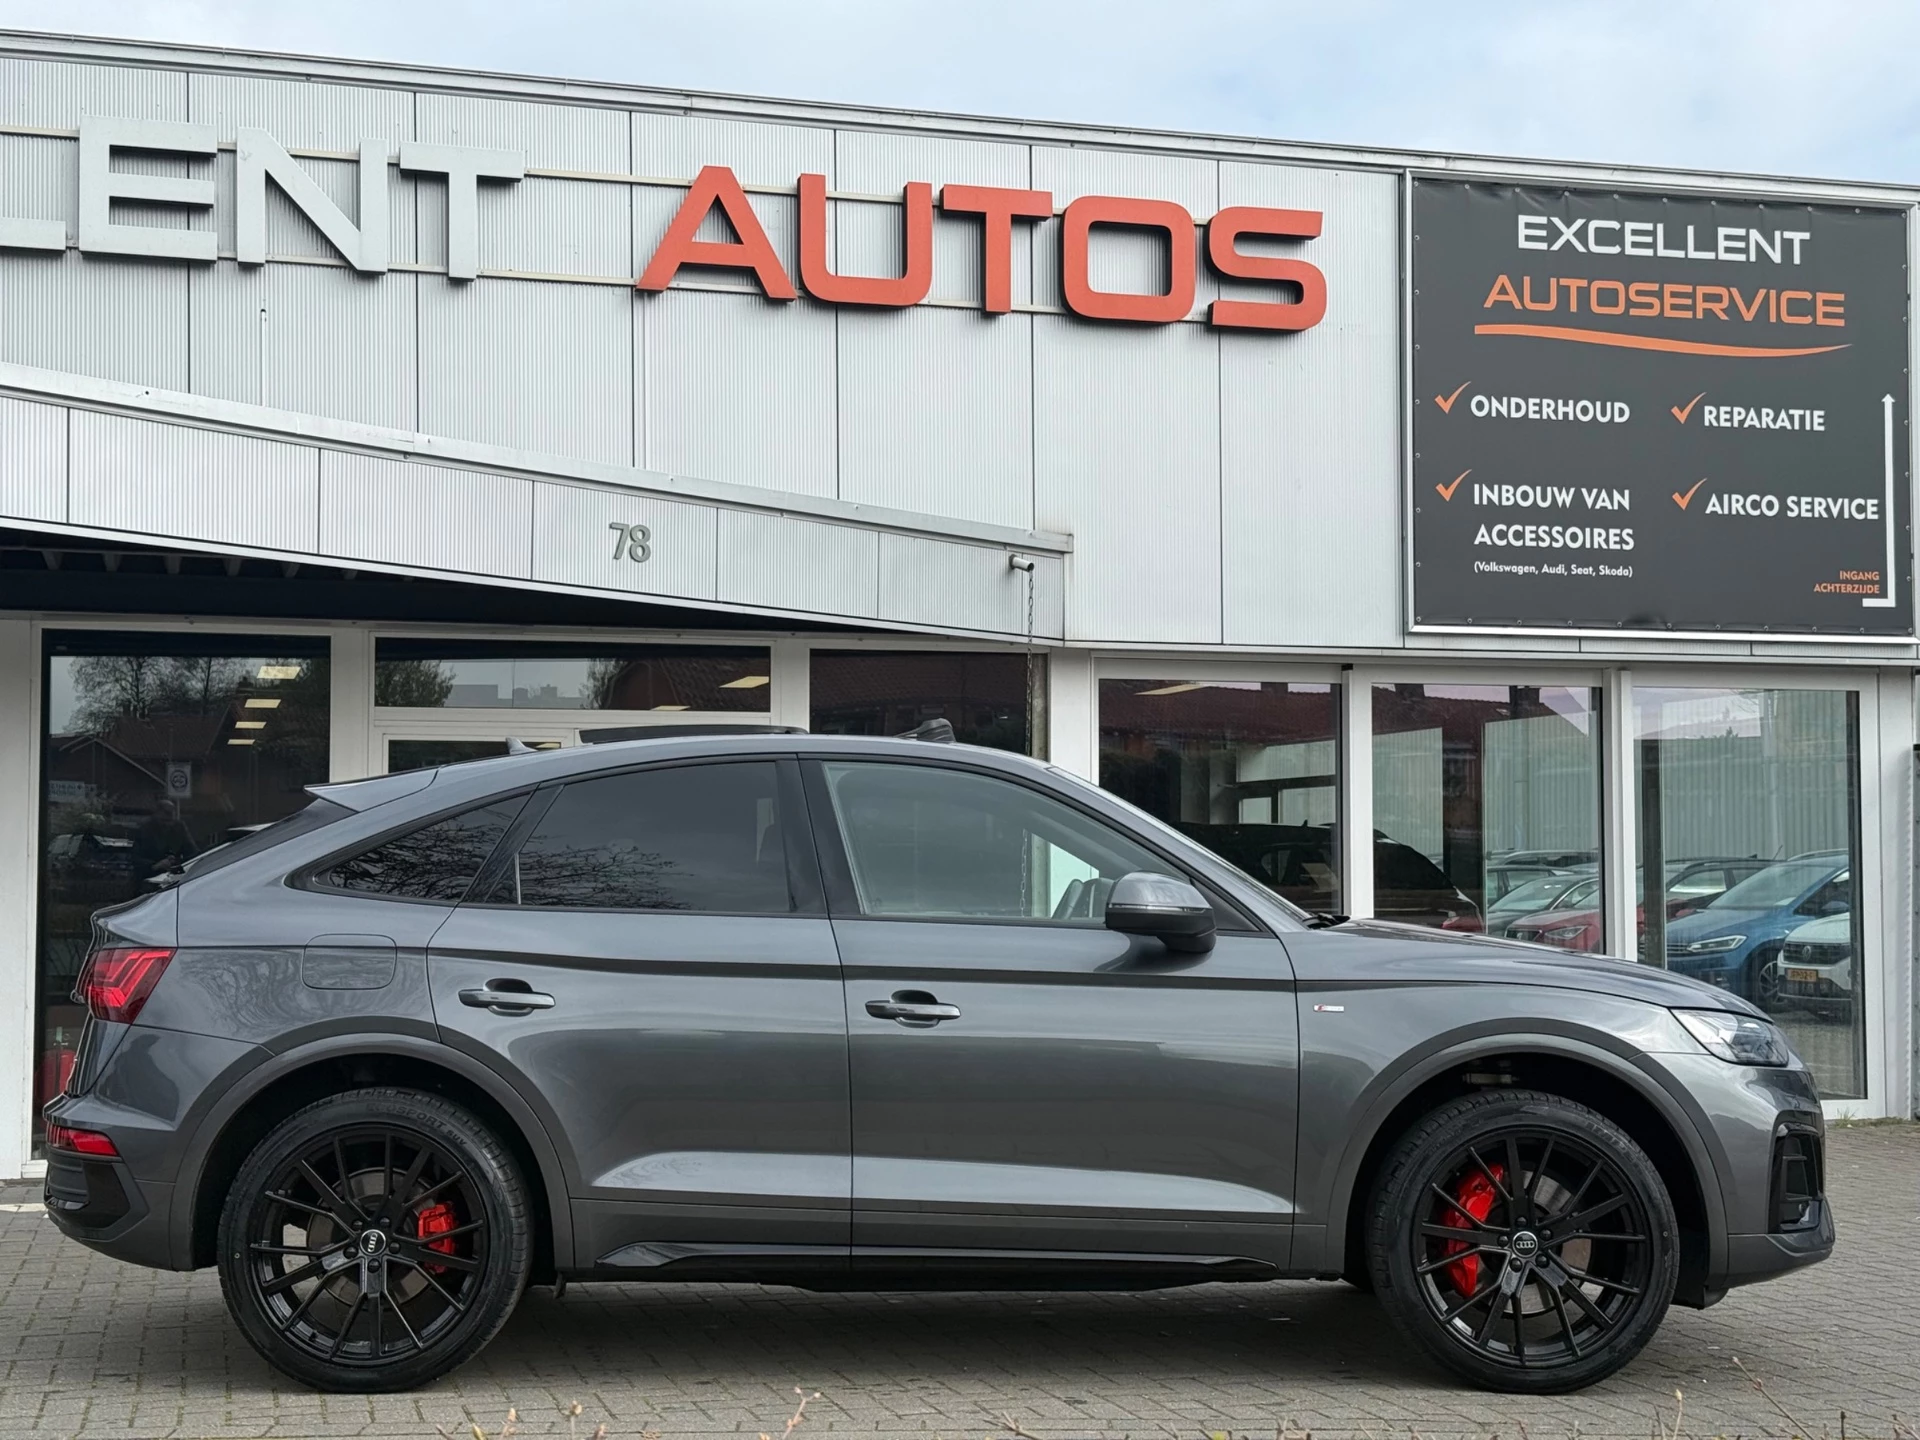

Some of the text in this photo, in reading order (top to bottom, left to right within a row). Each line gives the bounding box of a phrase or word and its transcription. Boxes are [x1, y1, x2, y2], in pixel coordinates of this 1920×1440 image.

[635, 165, 1328, 332] AUTOS
[1517, 214, 1811, 265] EXCELLENT
[1483, 274, 1846, 327] AUTOSERVICE
[1470, 394, 1631, 423] ONDERHOUD
[1703, 405, 1826, 432] REPARATIE
[1473, 483, 1631, 512] INBOUW VAN
[1704, 493, 1880, 520] AIRCO SERVICE
[609, 521, 652, 563] 78
[1473, 523, 1635, 551] ACCESSOIRES
[1474, 560, 1633, 578] (Volkswagen, Audi, Seat, Skoda)
[1839, 570, 1880, 581] INGANG
[1813, 583, 1881, 594] ACHTERZIJDE
